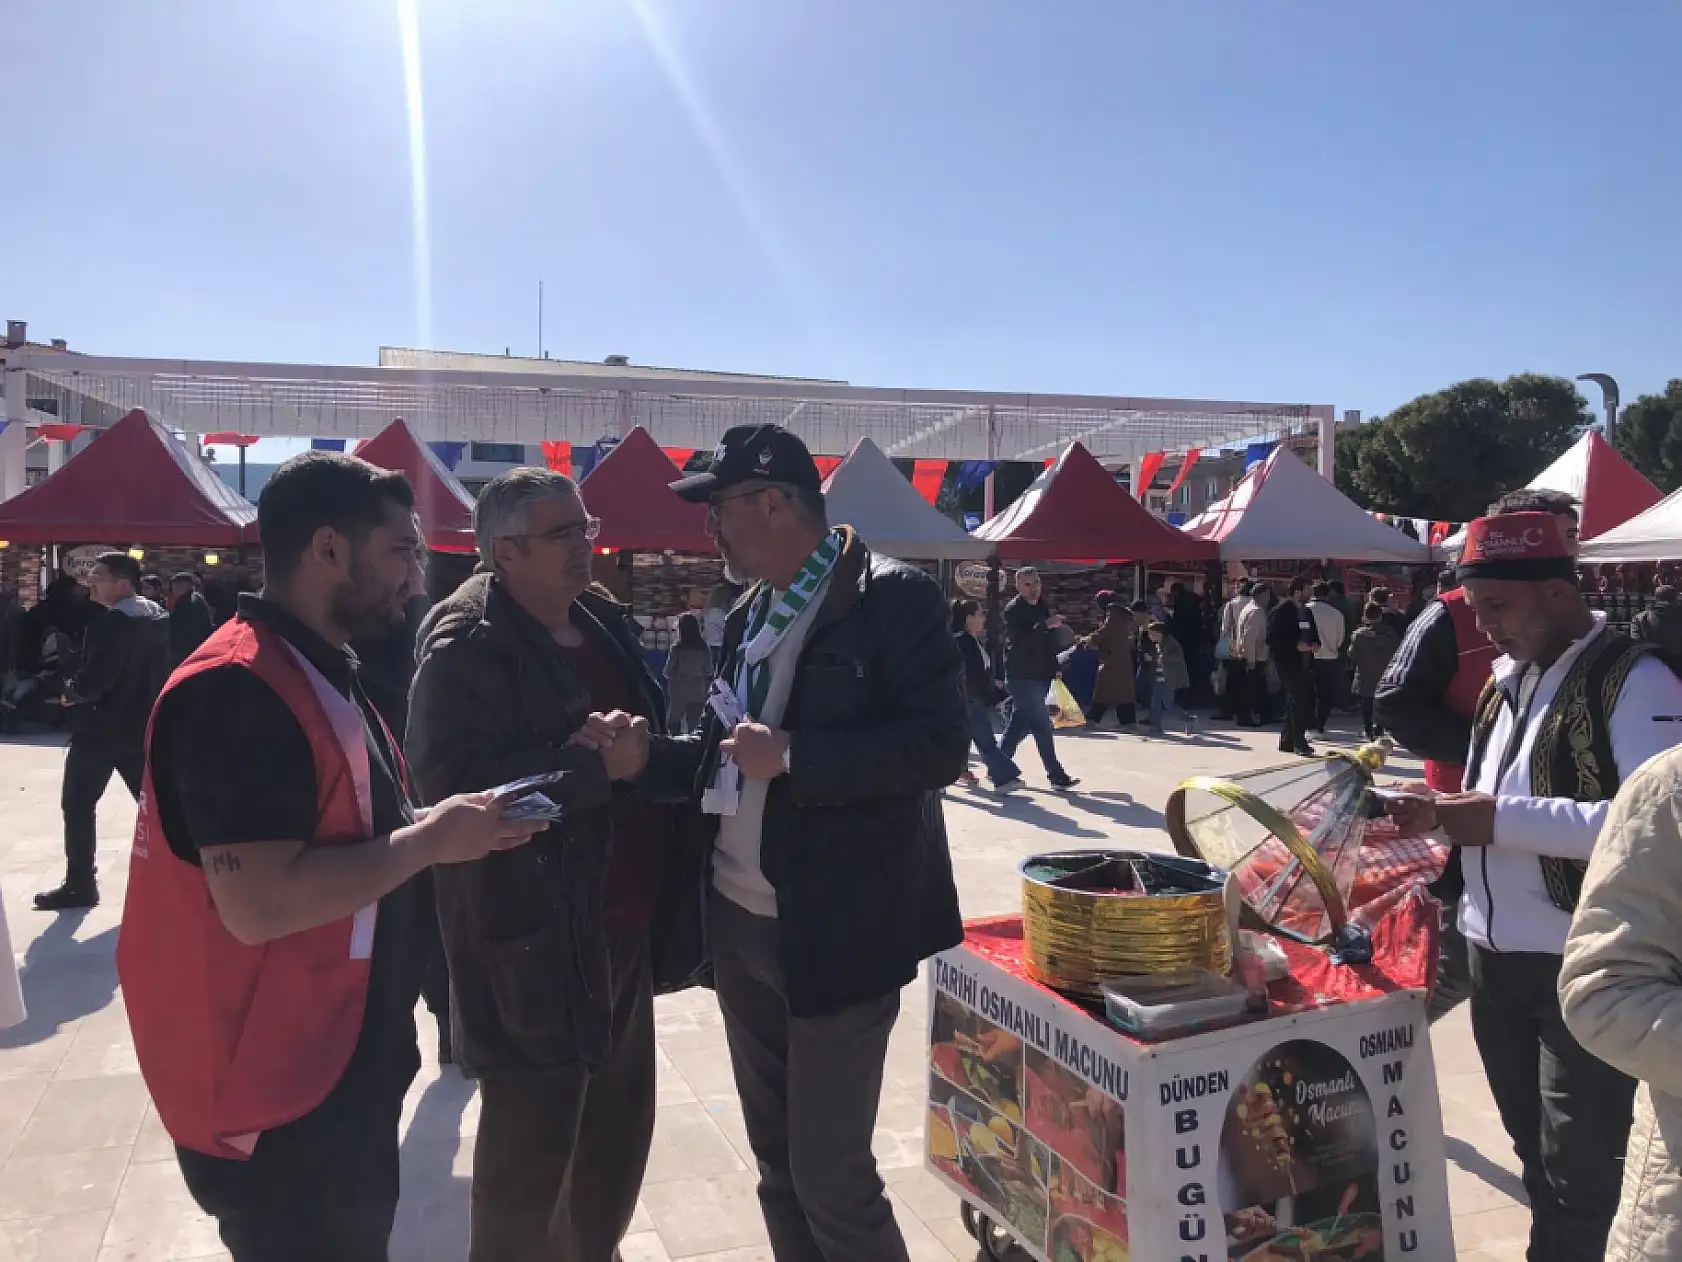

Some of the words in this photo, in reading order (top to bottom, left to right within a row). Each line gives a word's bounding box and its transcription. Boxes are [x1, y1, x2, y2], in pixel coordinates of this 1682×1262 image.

[934, 956, 978, 1007] TARİHİ
[980, 985, 1051, 1052] OSMANLI
[1055, 1027, 1130, 1102] MACUNU
[1359, 1023, 1414, 1059] OSMANLI
[1159, 1068, 1229, 1107] DÜNDEN
[1382, 1060, 1418, 1252] MACUNU
